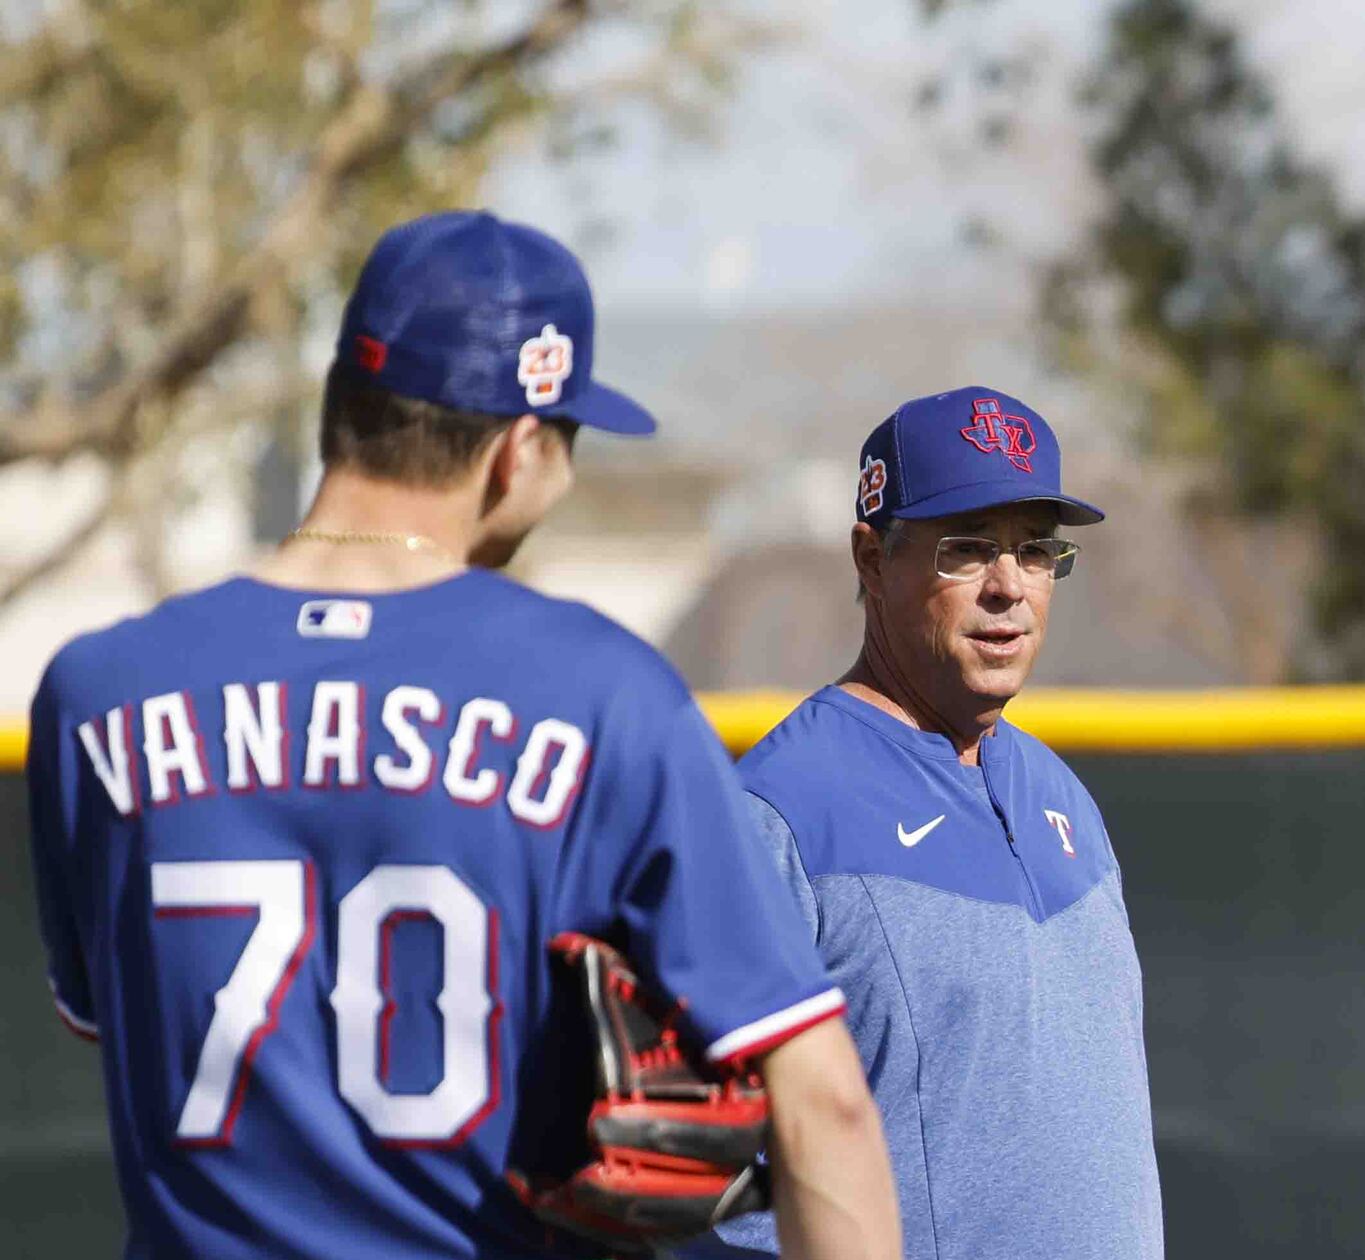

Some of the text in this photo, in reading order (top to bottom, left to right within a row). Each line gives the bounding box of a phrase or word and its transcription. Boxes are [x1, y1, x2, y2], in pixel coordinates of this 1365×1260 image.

[78, 682, 590, 829] VANASCO
[1044, 809, 1075, 858] T
[151, 860, 505, 1149] 70
